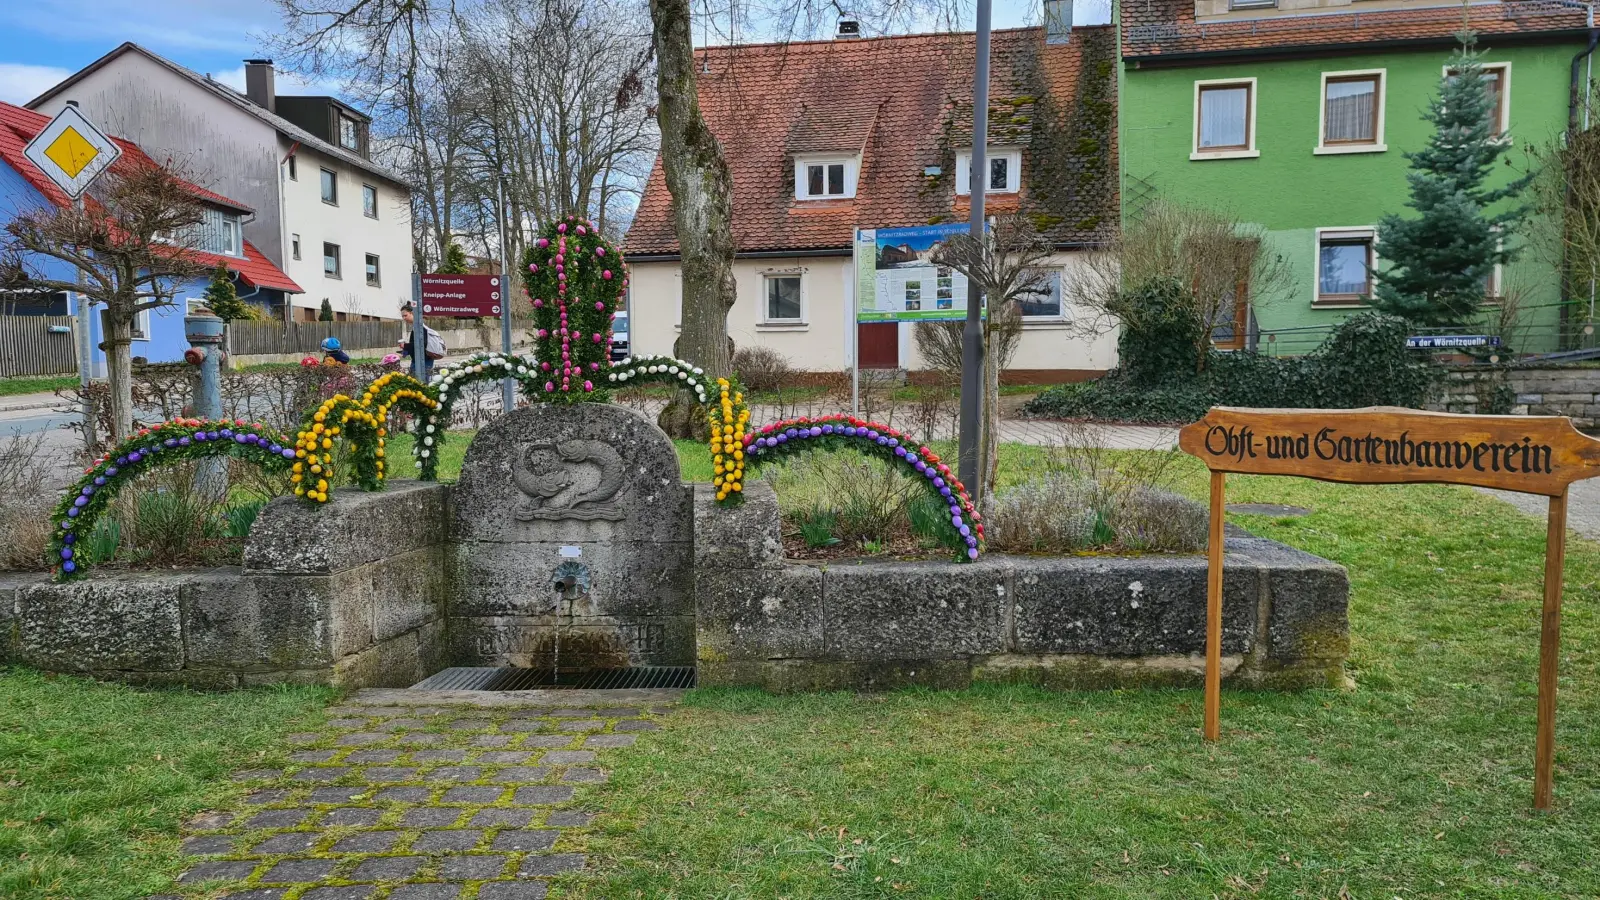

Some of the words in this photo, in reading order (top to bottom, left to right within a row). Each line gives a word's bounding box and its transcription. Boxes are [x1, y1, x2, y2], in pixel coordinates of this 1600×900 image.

[1277, 254, 1283, 262] 2
[1406, 339, 1415, 347] An
[1419, 338, 1431, 346] der
[1433, 337, 1486, 347] Wörnitzquelle
[1314, 425, 1553, 475] Gartenbauverein
